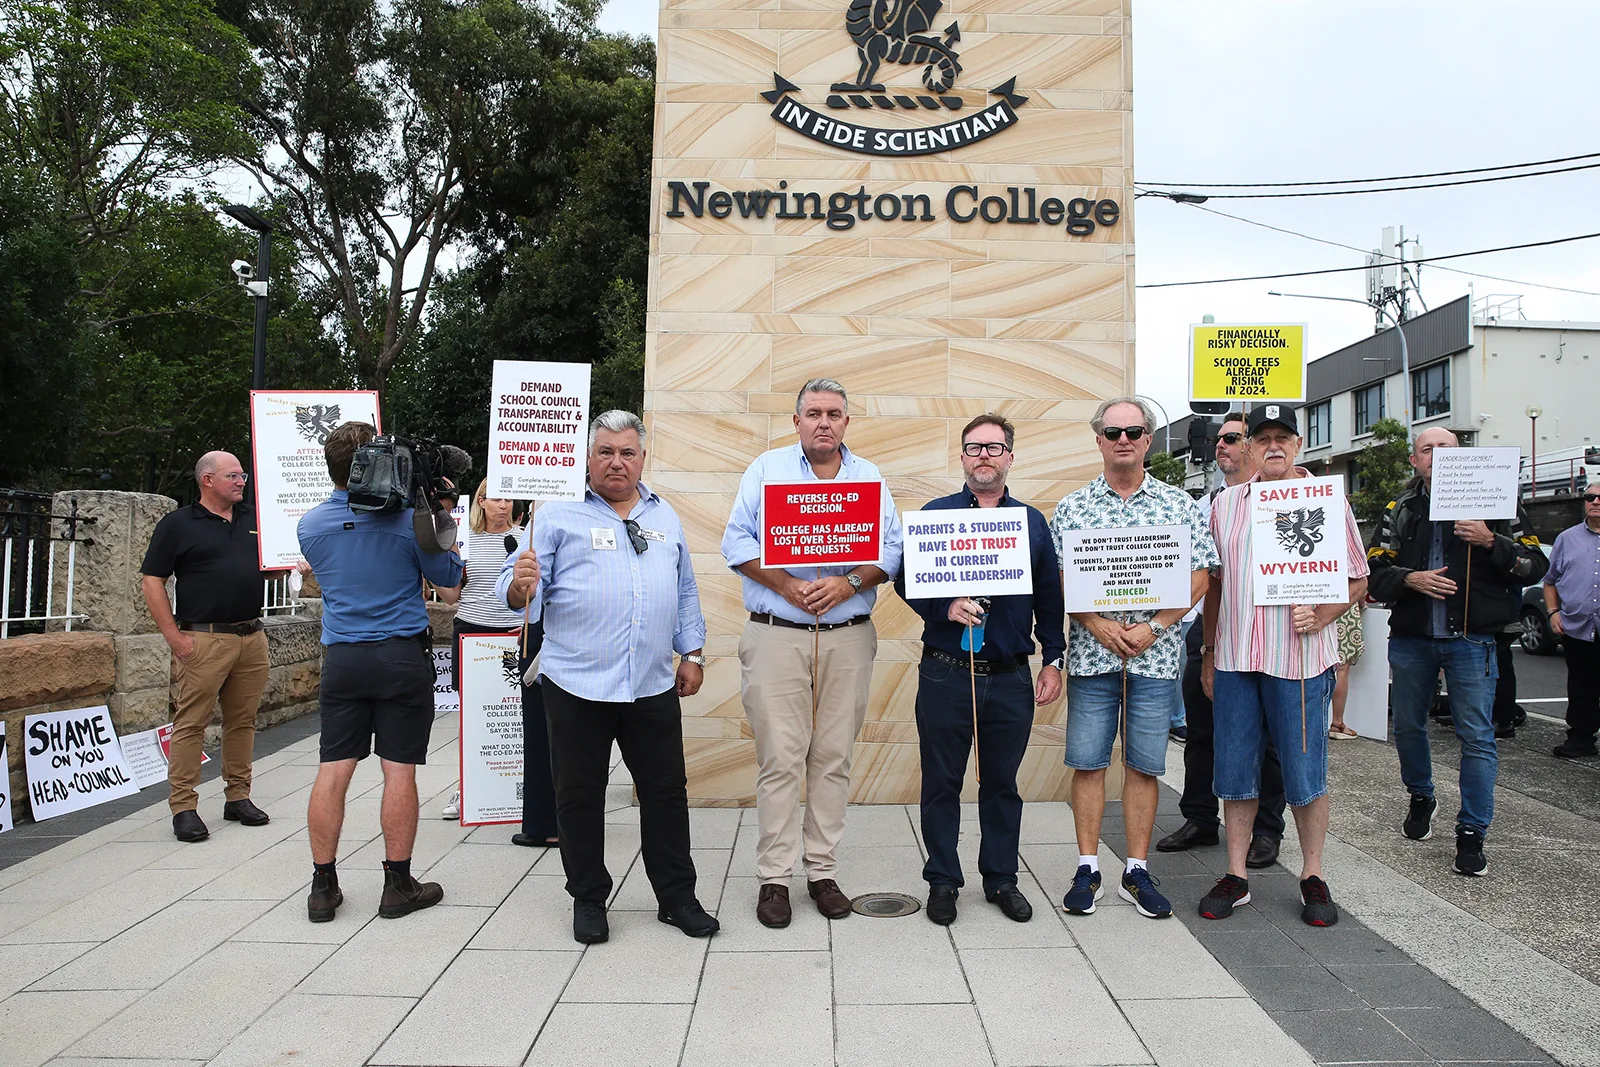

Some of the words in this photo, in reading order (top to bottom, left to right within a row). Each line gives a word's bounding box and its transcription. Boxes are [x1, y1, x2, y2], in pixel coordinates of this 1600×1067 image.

[779, 101, 809, 130] IN
[812, 117, 866, 149] FIDE
[874, 104, 1010, 152] SCIENTIAM
[666, 180, 936, 230] Newington
[946, 185, 1120, 236] College
[1218, 329, 1280, 338] FINANCIALLY
[1208, 340, 1236, 348] RISKY
[1240, 339, 1289, 348] DECISION.
[1214, 358, 1252, 367] SCHOOL
[1256, 358, 1280, 366] FEES
[1226, 368, 1270, 376] ALREADY
[521, 382, 562, 392] DEMAND
[1232, 377, 1264, 385] RISING
[1226, 386, 1235, 395] IN
[1240, 386, 1269, 395] 2024.
[501, 395, 538, 405] SCHOOL
[541, 396, 581, 407] COUNCIL
[498, 408, 572, 420] TRANSPARENCY
[576, 411, 582, 420] &
[497, 422, 578, 434] ACCOUNTABILITY
[499, 441, 540, 452] DEMAND
[543, 443, 549, 452] A
[553, 444, 575, 453] NEW
[501, 455, 525, 465] VOTE
[528, 456, 542, 465] ON
[545, 456, 575, 466] CO-ED
[787, 494, 828, 504] REVERSE
[831, 493, 859, 502] CO-ED
[1260, 488, 1298, 502] SAVE
[1304, 485, 1333, 498] THE
[800, 504, 845, 513] DECISION.
[770, 526, 809, 535] COLLEGE
[813, 525, 830, 533] HAS
[834, 523, 874, 532] ALREADY
[908, 524, 954, 535] PARENTS
[959, 523, 966, 533] &
[971, 521, 1022, 532] STUDENTS
[774, 536, 796, 545] LOST
[800, 536, 824, 544] OVER
[827, 534, 870, 544] $5million
[919, 541, 947, 552] HAVE
[951, 539, 977, 551] LOST
[981, 537, 1017, 549] TRUST
[792, 546, 801, 555] IN
[804, 544, 852, 555] BEQUESTS.
[935, 556, 946, 567] IN
[951, 554, 998, 566] CURRENT
[1260, 560, 1338, 575] WYVERN!
[915, 572, 956, 583] SCHOOL
[960, 569, 1024, 581] LEADERSHIP
[1106, 588, 1148, 596] SILENCED!
[29, 715, 111, 756] SHAME
[52, 754, 71, 768] ON
[75, 748, 104, 767] YOU
[32, 779, 69, 805] HEAD
[74, 765, 130, 793] COUNCIL
